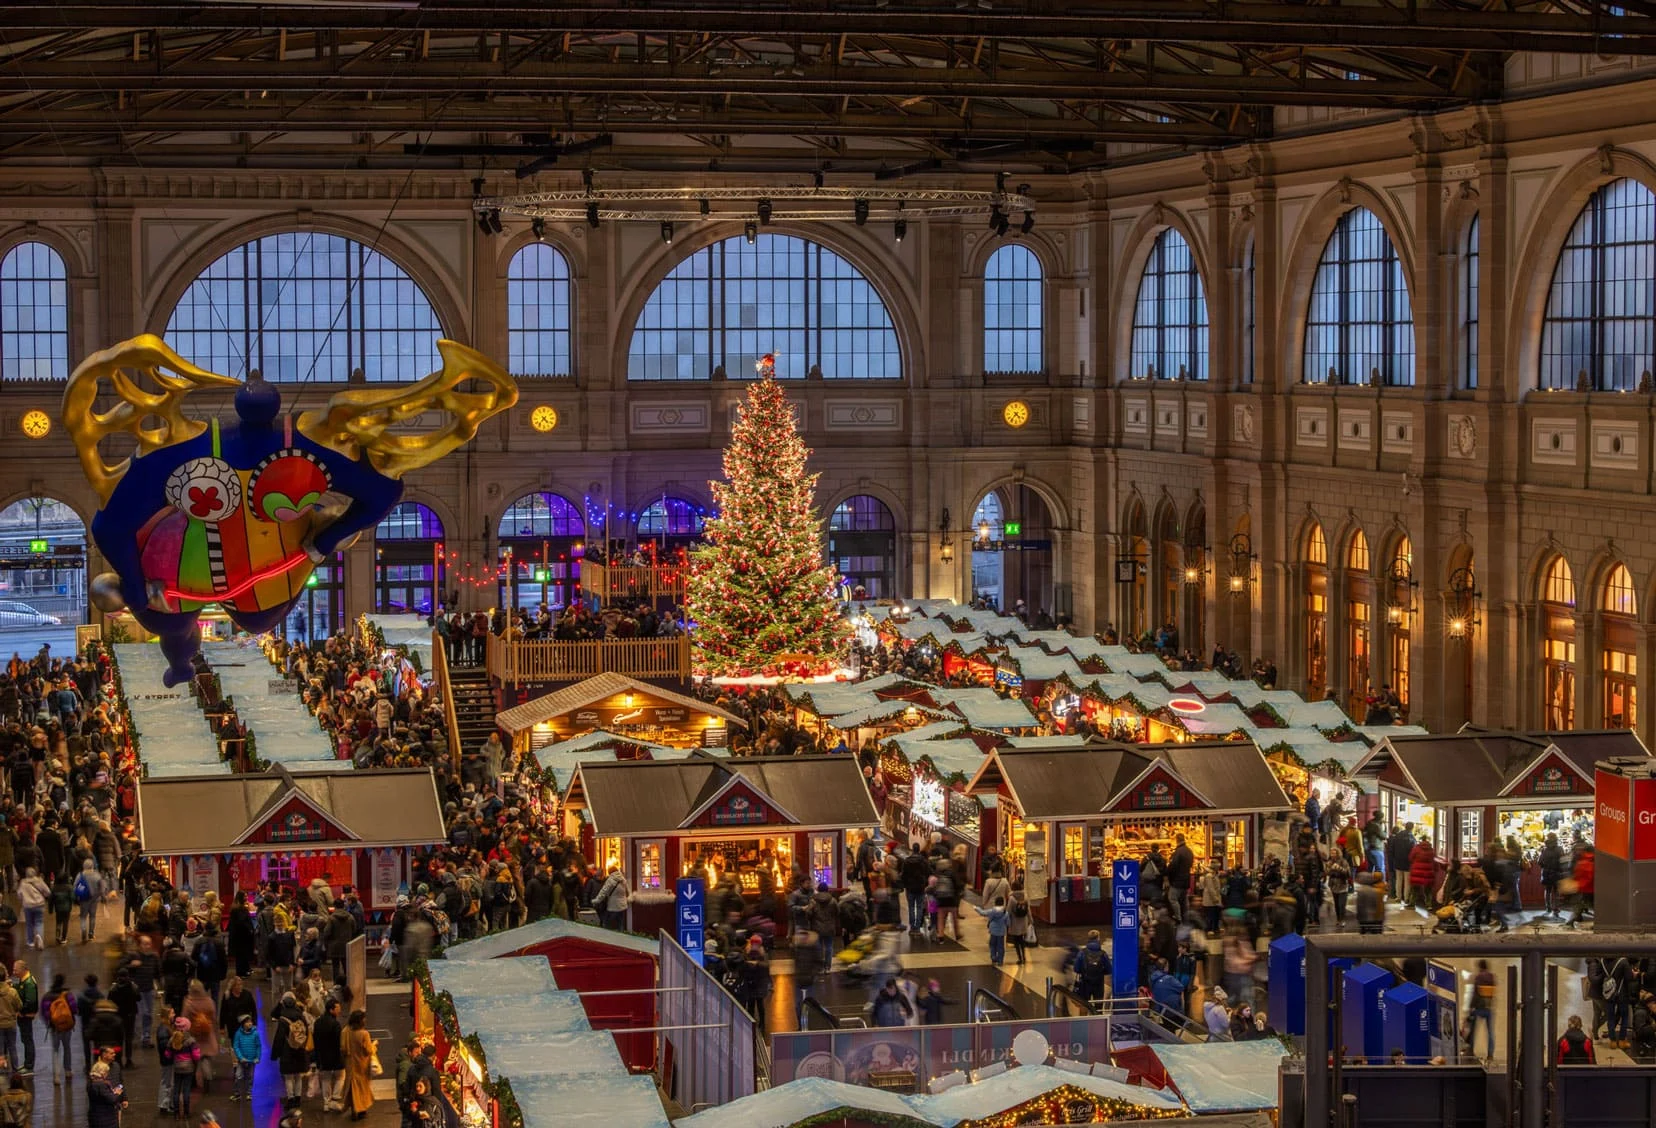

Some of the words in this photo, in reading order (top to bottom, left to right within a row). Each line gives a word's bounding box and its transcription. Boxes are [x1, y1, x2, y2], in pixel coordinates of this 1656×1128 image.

[1600, 802, 1626, 823] Groups
[1638, 810, 1656, 825] Gr
[1076, 1104, 1094, 1115] Grill
